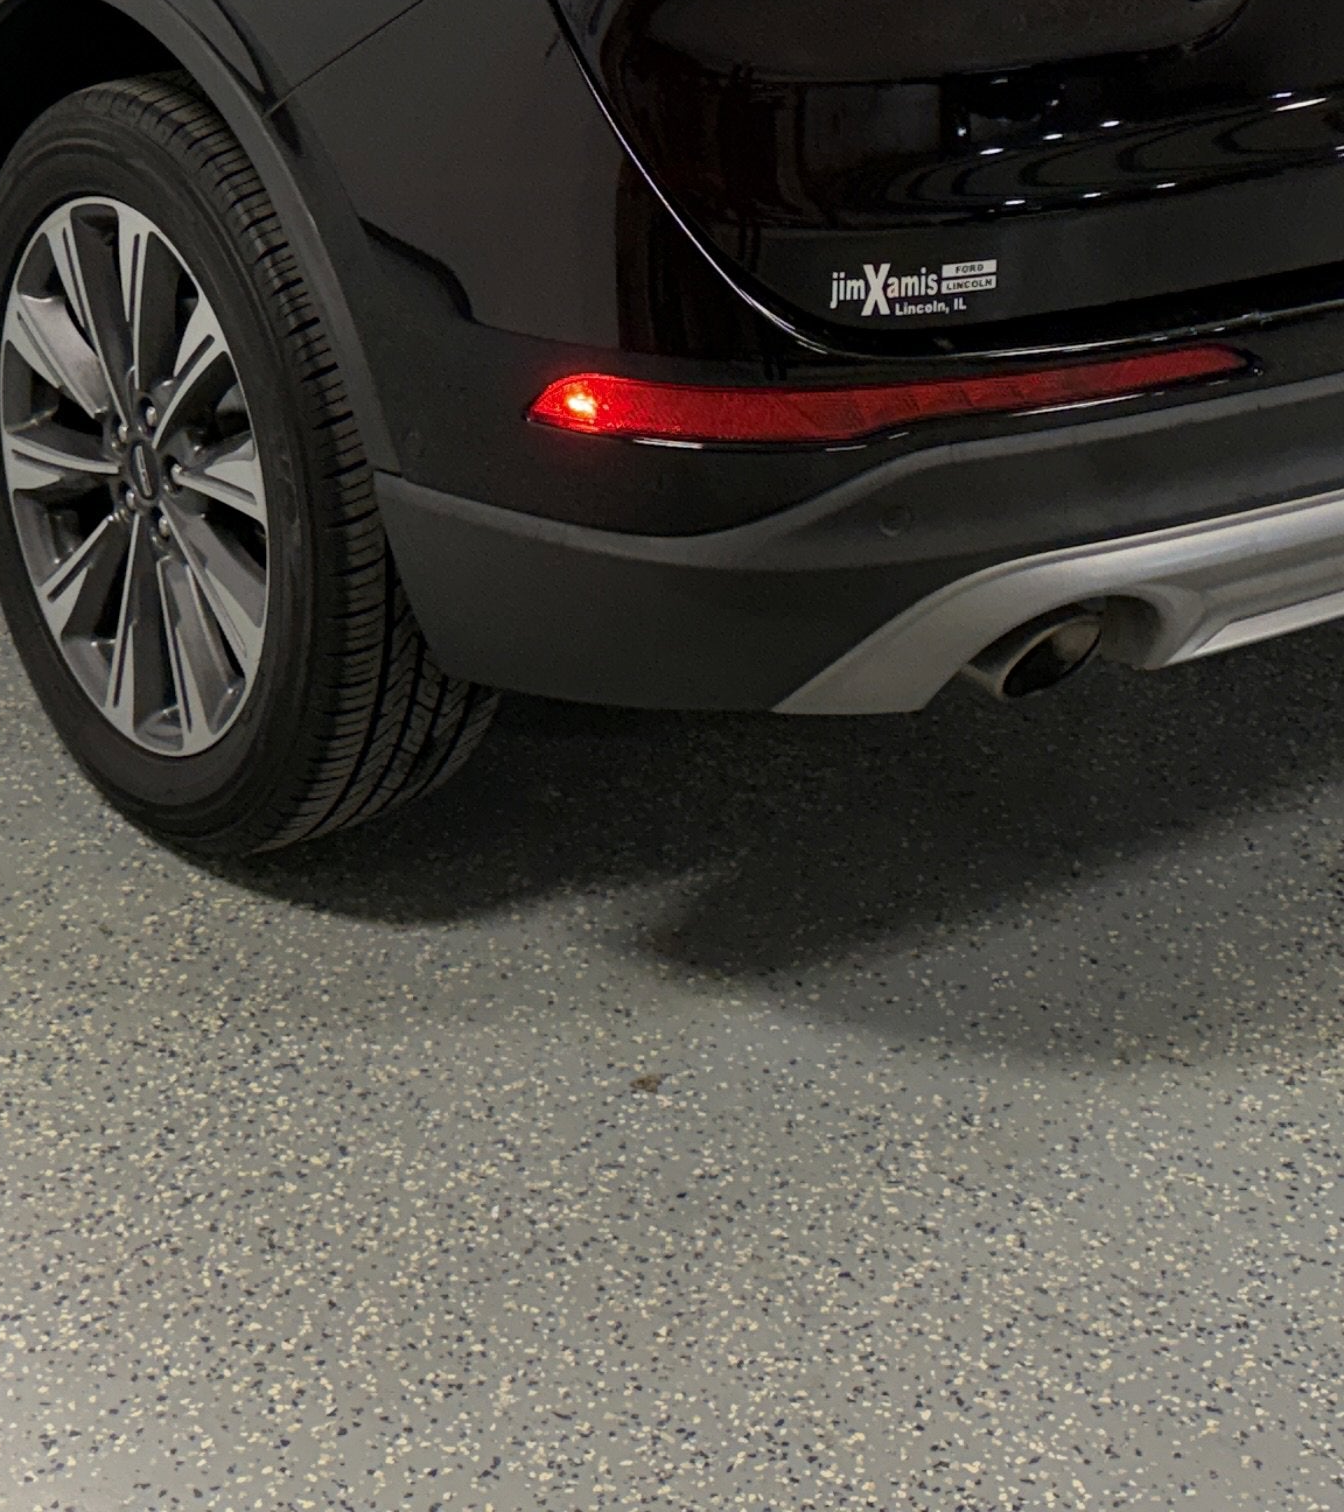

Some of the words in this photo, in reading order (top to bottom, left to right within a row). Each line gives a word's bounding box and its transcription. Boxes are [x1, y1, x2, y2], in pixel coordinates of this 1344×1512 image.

[955, 263, 985, 274] FORD
[946, 279, 993, 291] LINCOLN
[895, 301, 950, 316] Lincoln,
[954, 298, 967, 310] IL
